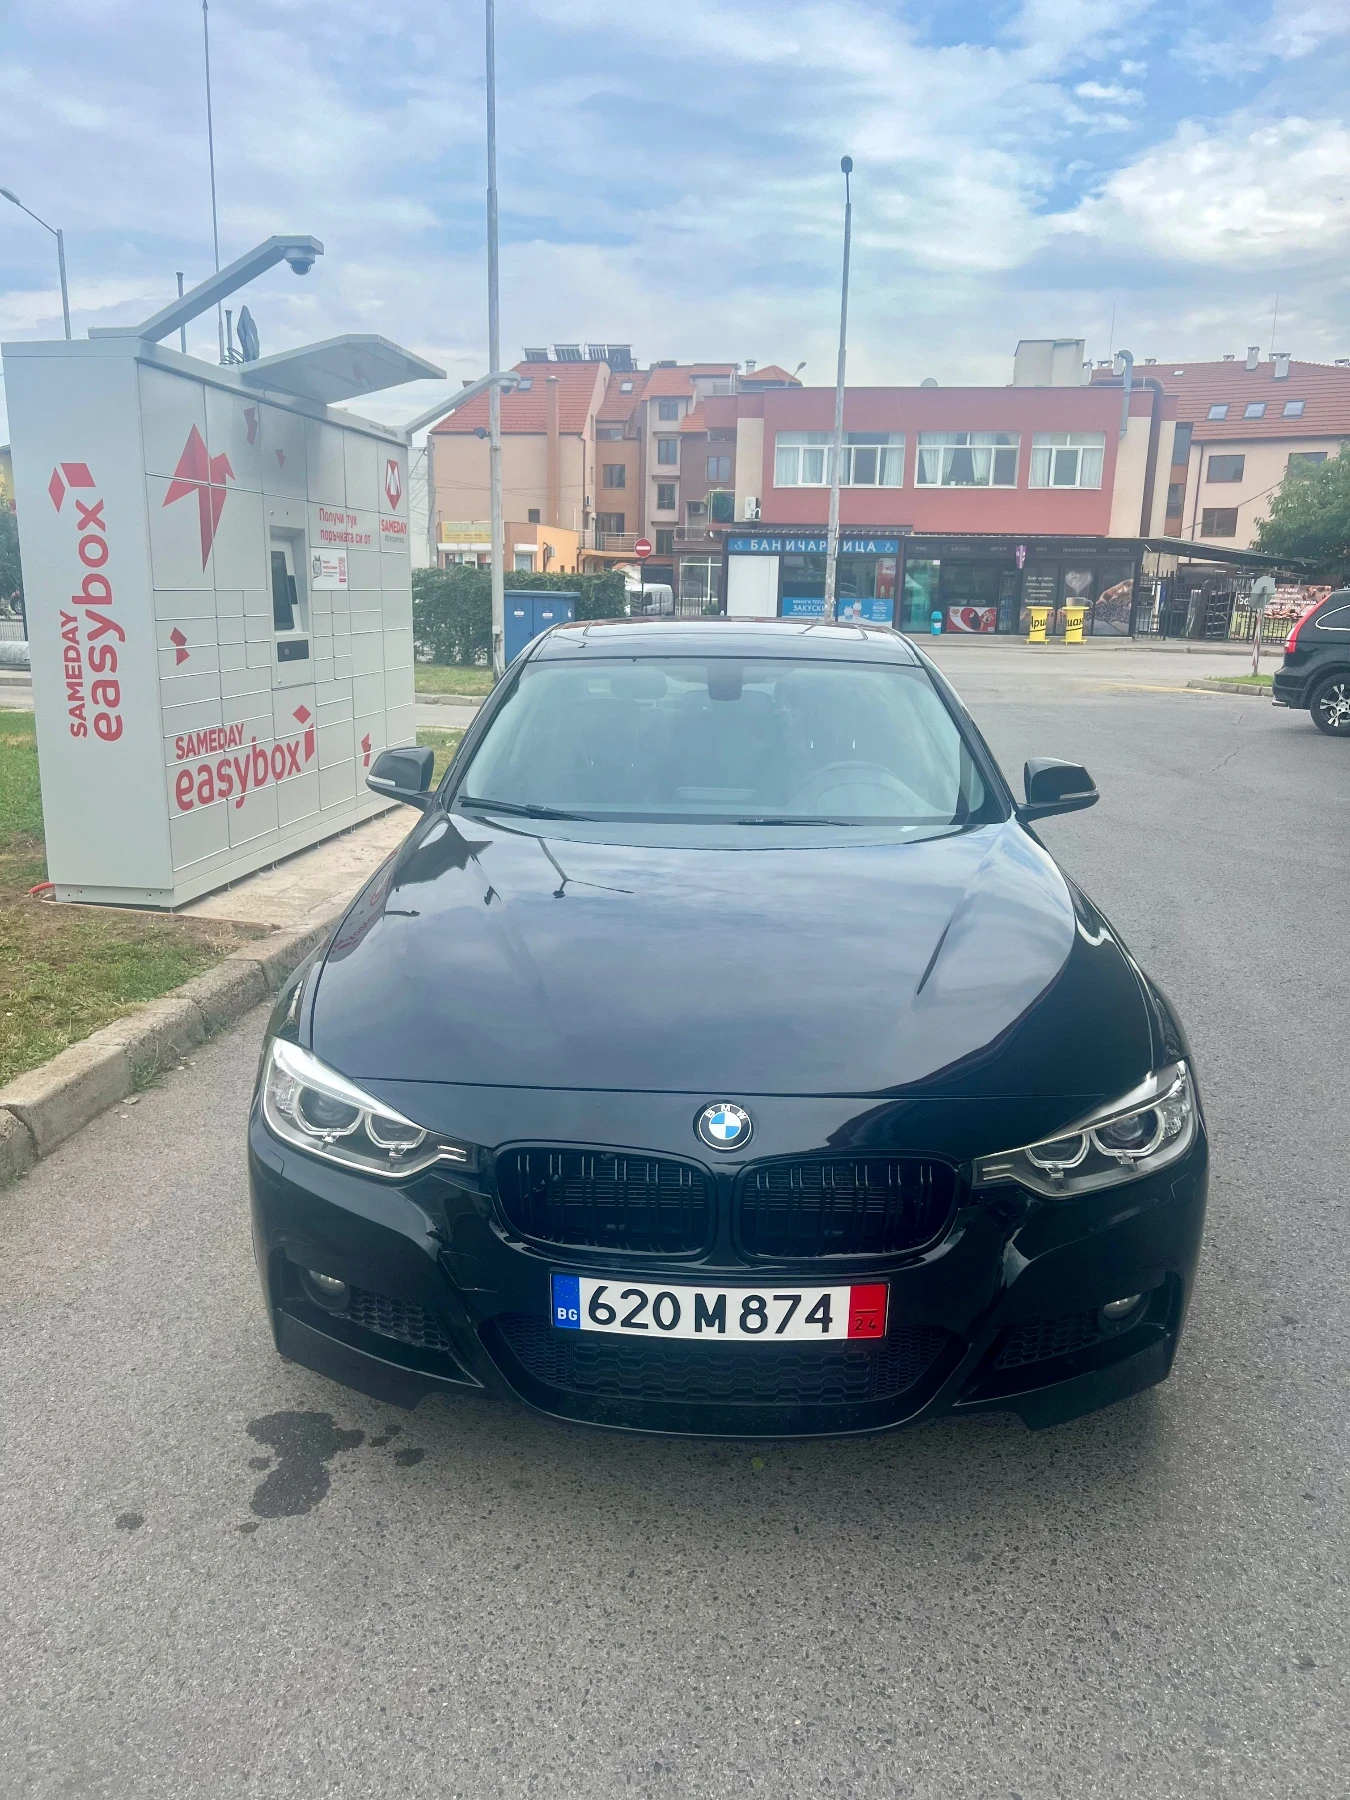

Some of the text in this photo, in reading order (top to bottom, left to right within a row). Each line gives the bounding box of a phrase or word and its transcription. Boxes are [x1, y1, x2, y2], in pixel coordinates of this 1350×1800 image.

[318, 507, 358, 529] Получи тук
[380, 518, 408, 535] SAMEDAY
[320, 529, 355, 544] поръчката
[355, 533, 363, 544] си
[363, 534, 371, 545] от
[750, 539, 877, 553] БАНИЧАРИЦА
[72, 498, 126, 742] easybox
[59, 608, 88, 738] SAMEDAY
[175, 722, 245, 760] SAMEDAY
[175, 735, 302, 811] easybox
[705, 1104, 748, 1120] BMW
[557, 1306, 578, 1322] BG
[588, 1285, 833, 1335] 620 M 874
[854, 1316, 878, 1331] 24
